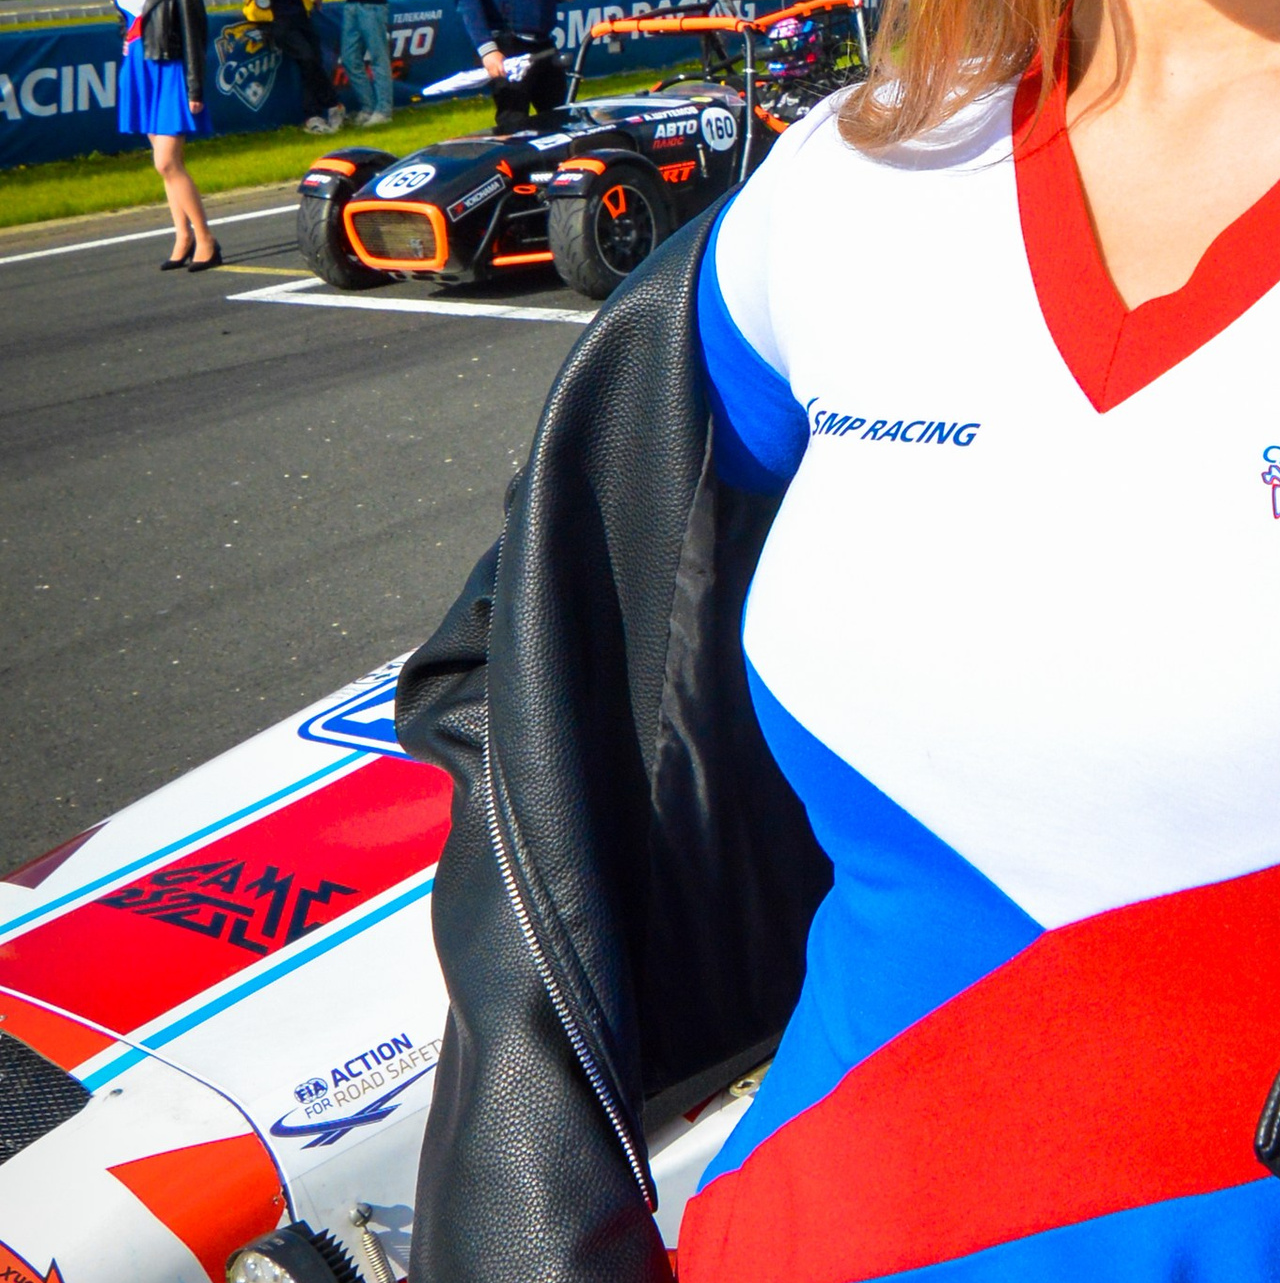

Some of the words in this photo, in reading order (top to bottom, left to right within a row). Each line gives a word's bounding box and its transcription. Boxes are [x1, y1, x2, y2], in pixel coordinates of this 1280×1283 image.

[393, 10, 442, 24] ТЕЛЕКАНАЛ
[219, 53, 276, 92] Сочи
[655, 120, 698, 138] АВТО
[706, 116, 734, 141] 160
[652, 137, 684, 150] ПЛЮС
[385, 171, 431, 188] 160
[463, 181, 500, 207] YOKOHAMA
[812, 411, 866, 437] SMP
[861, 419, 981, 447] RACING
[295, 1080, 327, 1104] FIA
[330, 1032, 413, 1088] ACTION
[304, 1097, 334, 1119] FOR
[333, 1071, 385, 1107] ROAD
